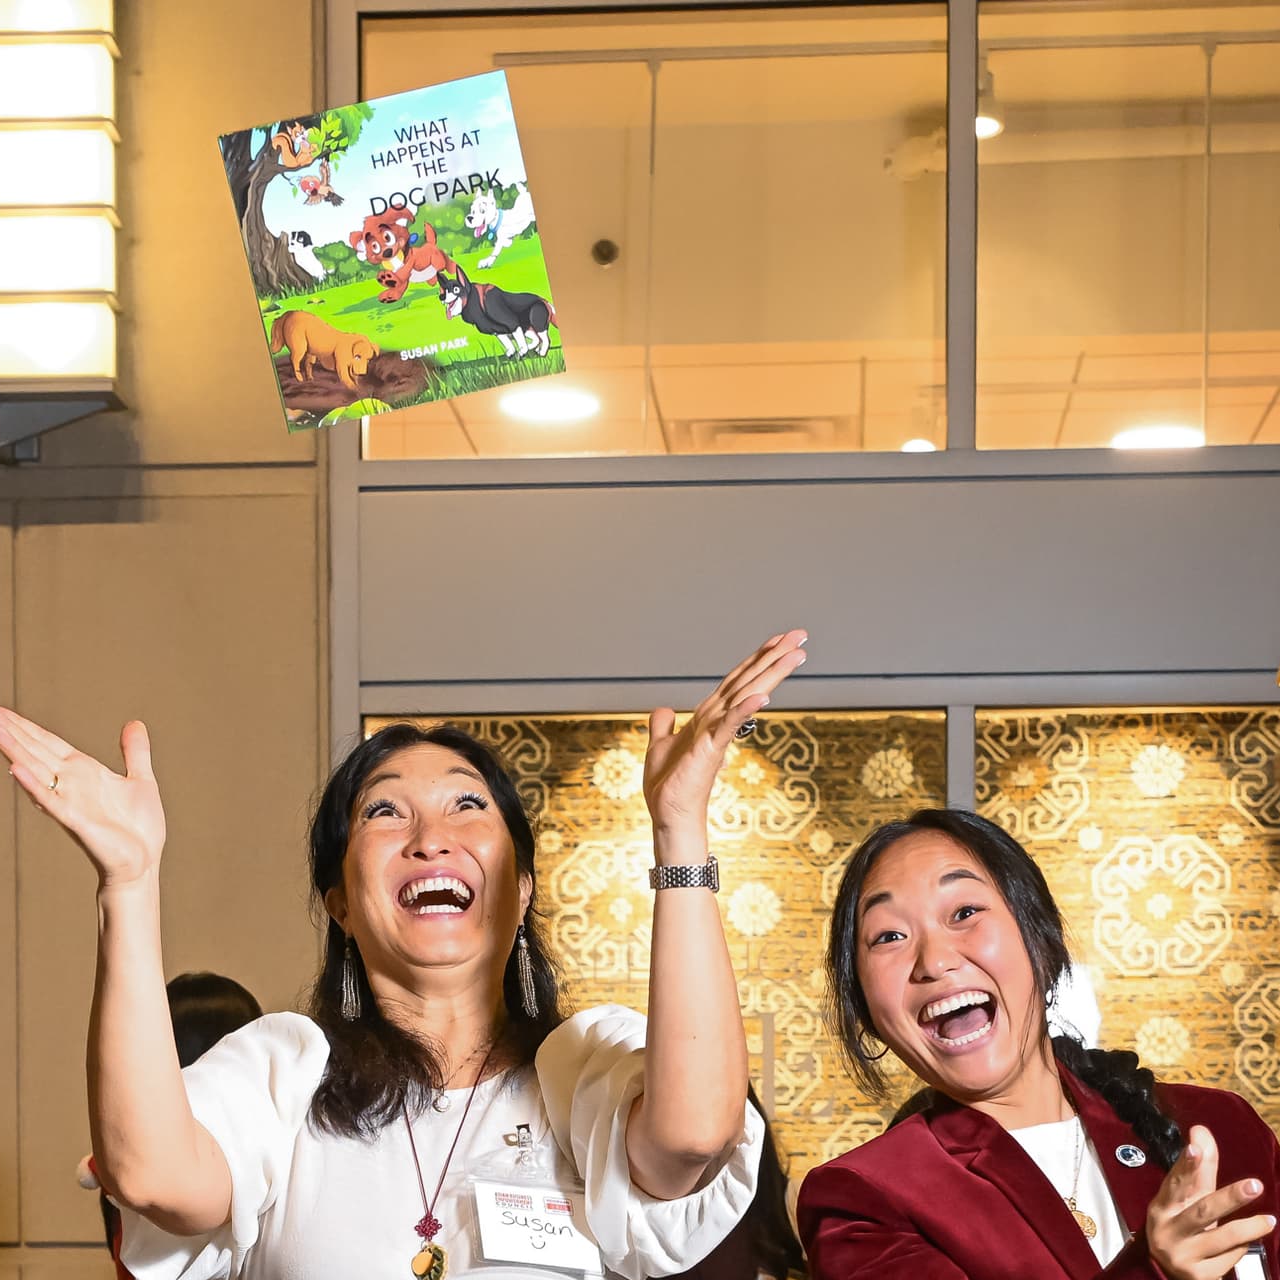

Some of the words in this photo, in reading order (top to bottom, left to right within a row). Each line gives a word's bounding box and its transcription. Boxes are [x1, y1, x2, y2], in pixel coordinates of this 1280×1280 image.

[394, 118, 449, 144] WHAT
[371, 139, 456, 170] HAPPENS
[460, 129, 482, 148] AT
[412, 158, 448, 178] THE
[369, 186, 427, 217] DOG
[434, 168, 504, 200] PARK
[399, 344, 439, 362] SUSAN
[440, 336, 470, 355] PARK
[501, 1211, 573, 1237] Susan
